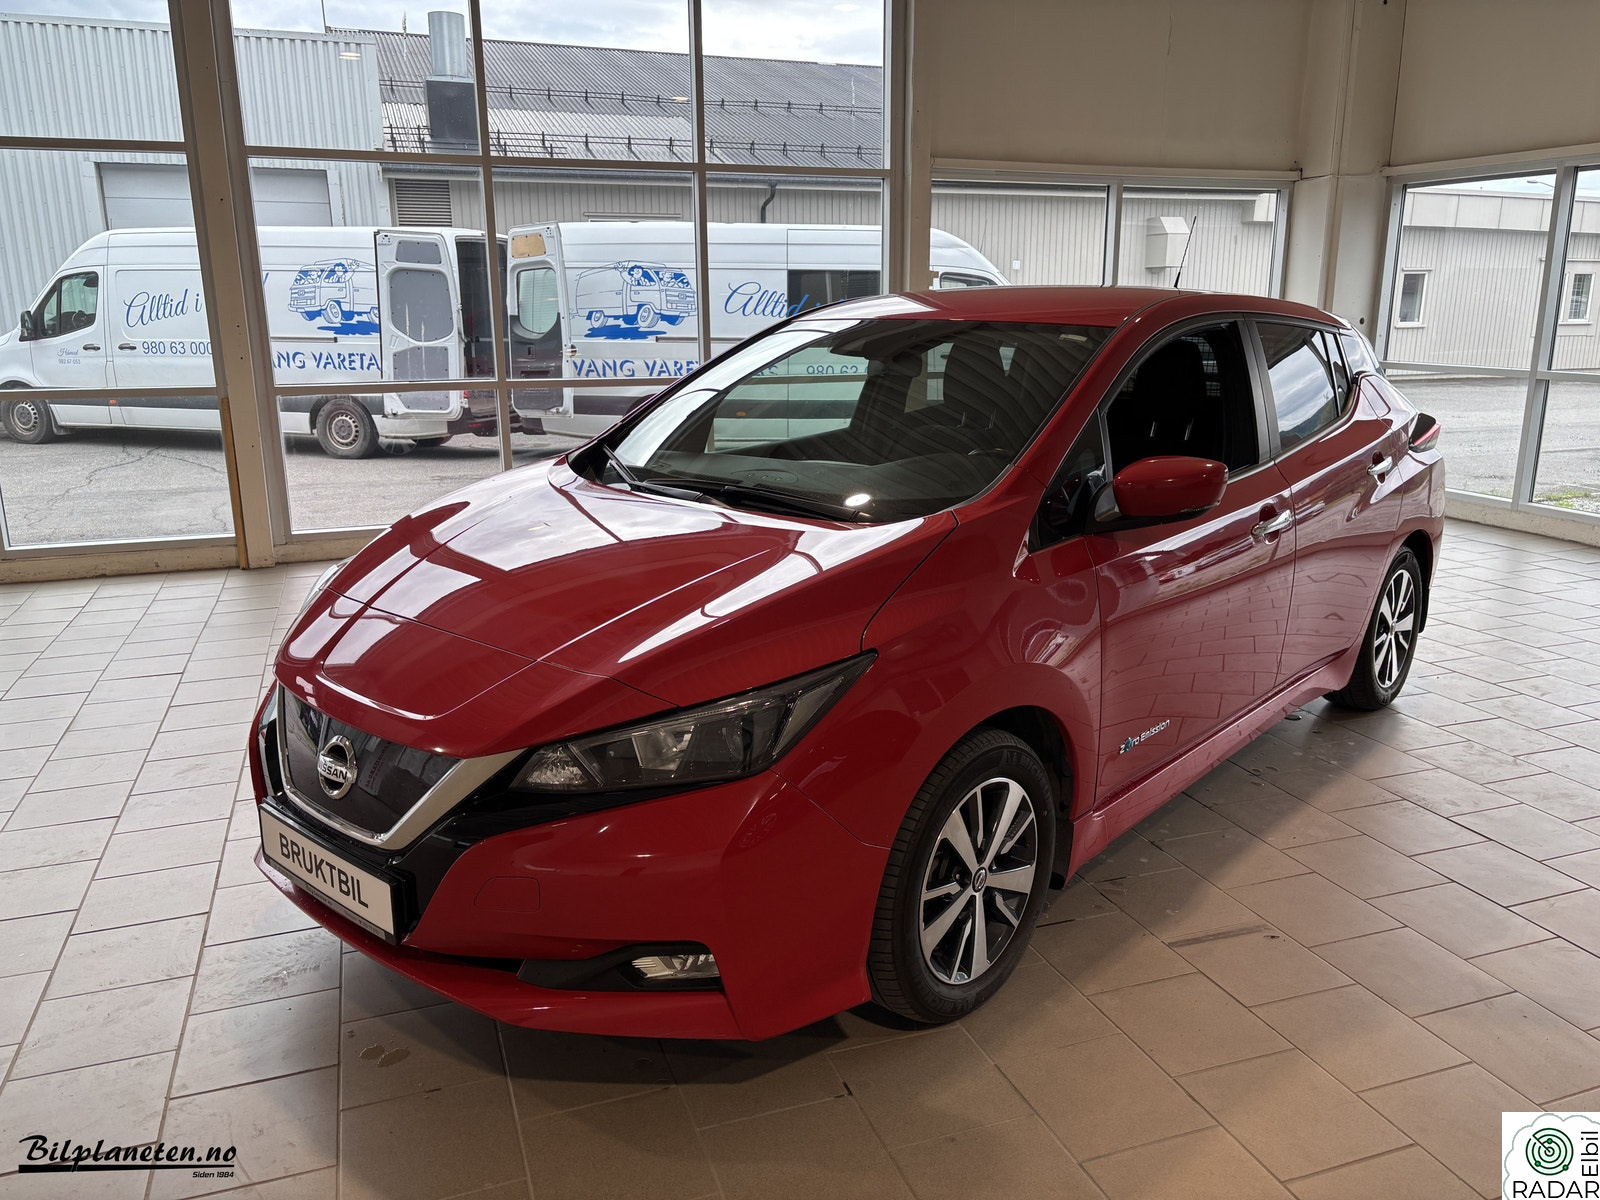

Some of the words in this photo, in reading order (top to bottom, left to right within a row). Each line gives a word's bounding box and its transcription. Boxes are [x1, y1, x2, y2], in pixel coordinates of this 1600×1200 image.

[123, 288, 188, 328] Alltid
[194, 293, 202, 312] i
[724, 281, 810, 318] Alltid
[142, 341, 166, 354] 980
[170, 341, 186, 355] 63
[573, 359, 635, 377] VANG
[644, 359, 699, 377] VARE
[317, 758, 348, 781] ISSAN
[278, 831, 369, 909] BRUKTBIL
